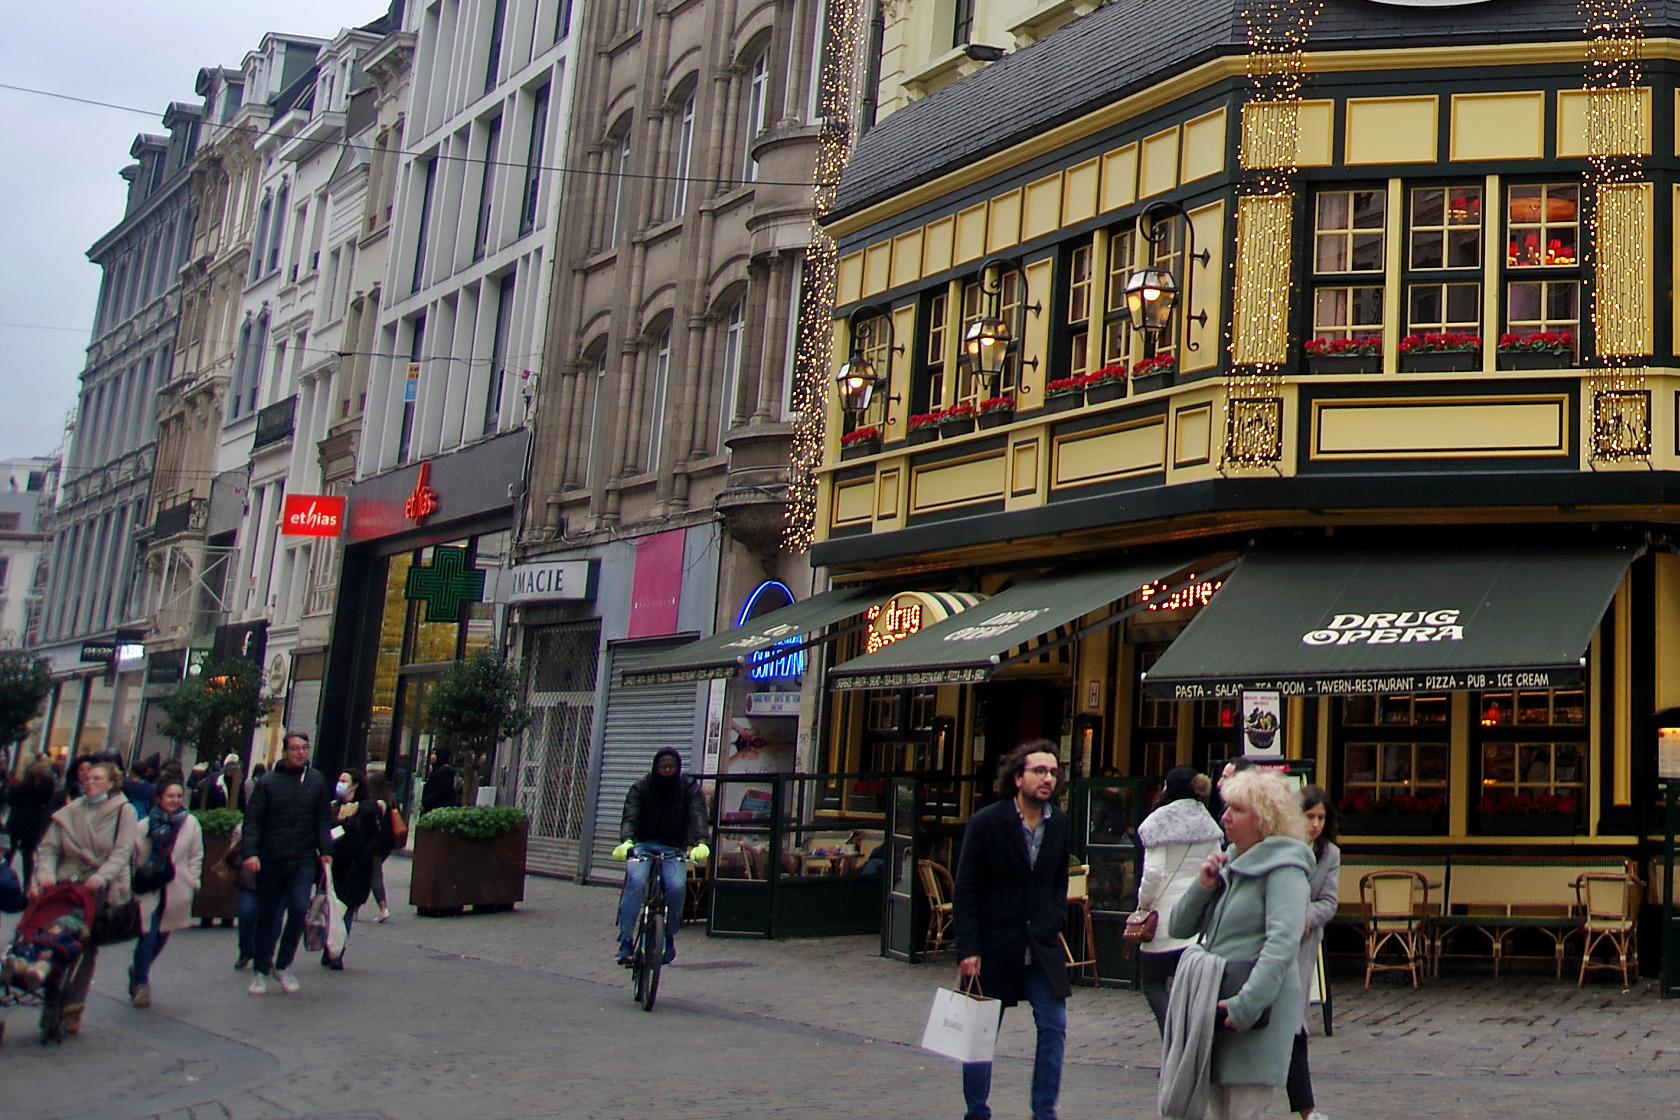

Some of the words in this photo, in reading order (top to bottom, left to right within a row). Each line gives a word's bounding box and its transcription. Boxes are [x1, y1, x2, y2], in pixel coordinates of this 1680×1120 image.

[290, 501, 337, 528] ethias
[885, 600, 920, 634] drug
[1328, 609, 1461, 629] DRUG
[1302, 625, 1464, 645] OPERA
[1175, 684, 1204, 698] PASTA
[1316, 677, 1414, 693] TAVERN-RESTAURANT
[1426, 675, 1456, 689] PIZZA
[1467, 674, 1485, 688] PUB
[1497, 674, 1512, 687] ICE
[1516, 673, 1549, 686] CREAM
